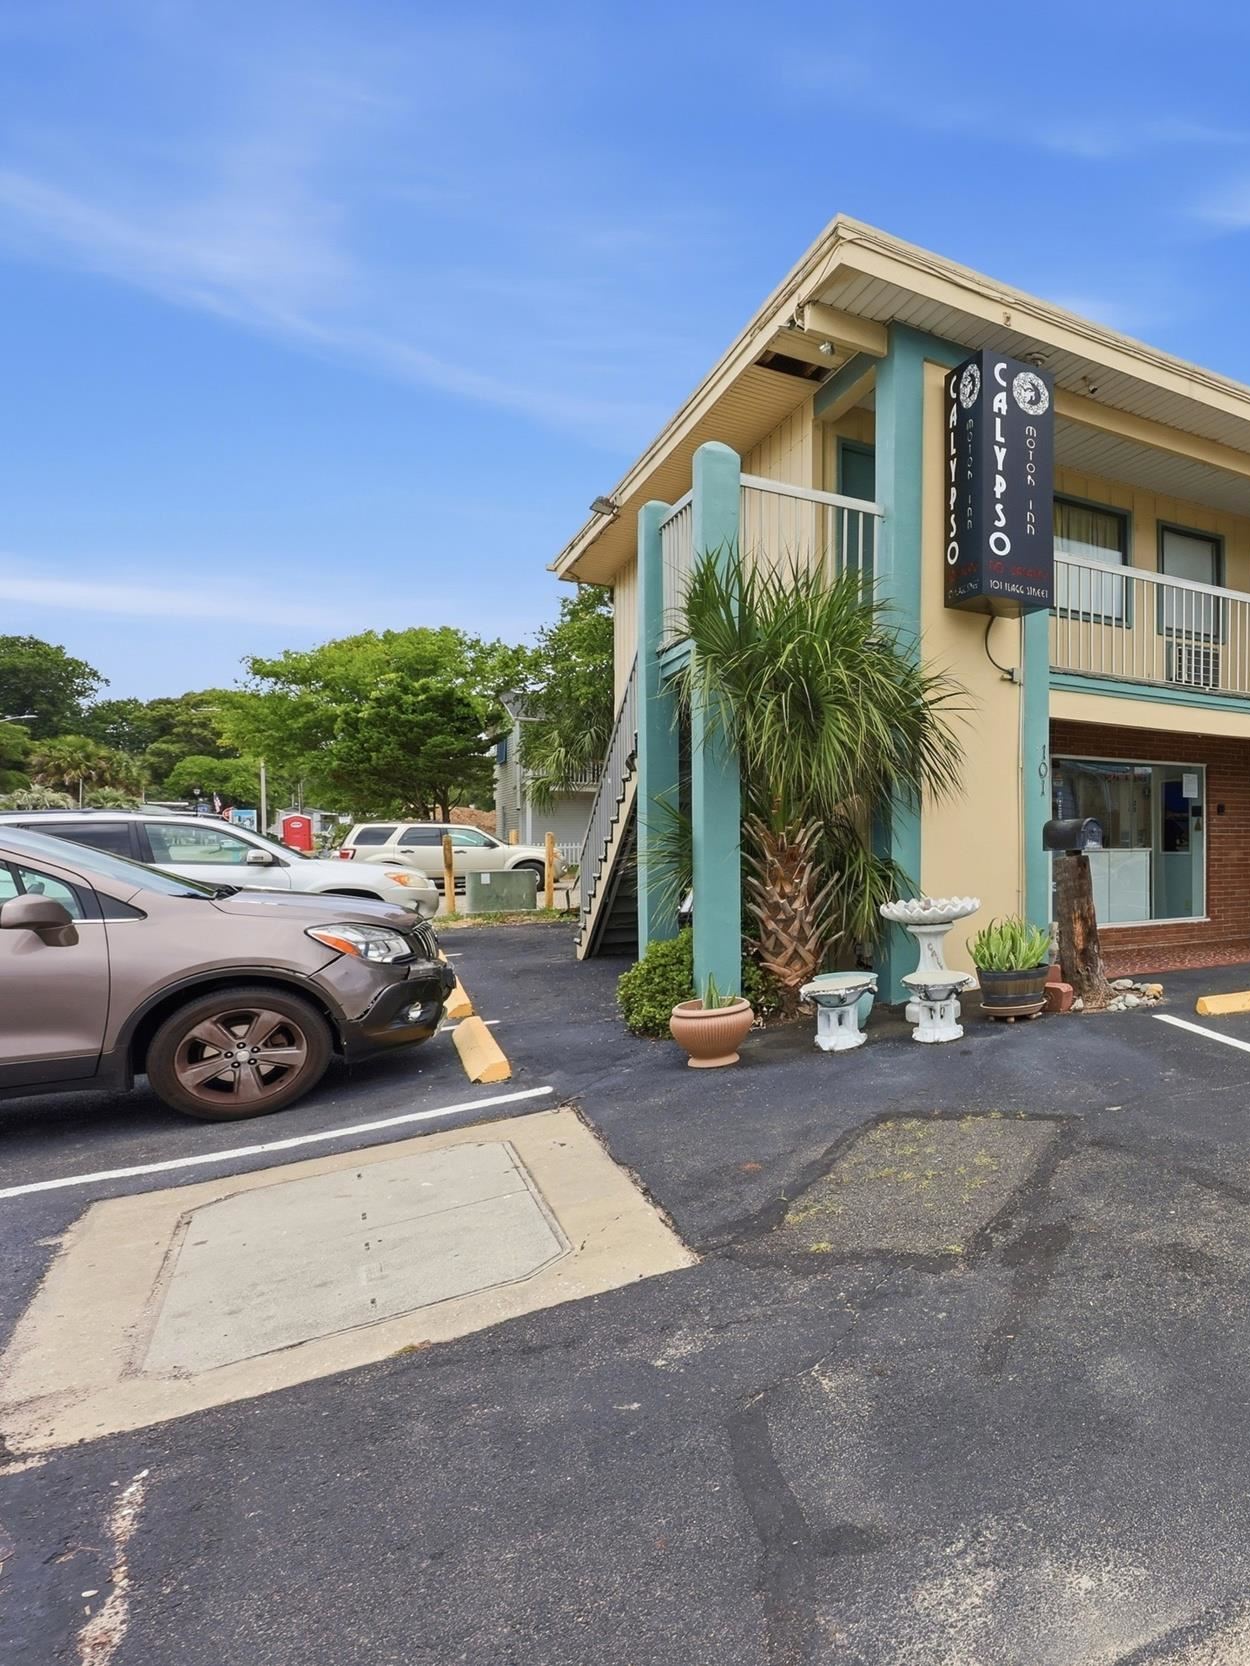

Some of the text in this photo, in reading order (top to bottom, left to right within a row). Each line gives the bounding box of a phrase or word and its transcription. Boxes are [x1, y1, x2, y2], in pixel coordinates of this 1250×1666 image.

[947, 375, 959, 565] CALYPSO
[989, 362, 1011, 556] CALYPSO
[990, 579, 1003, 590] 101
[1026, 586, 1049, 599] STREET
[1038, 744, 1048, 797] 101
